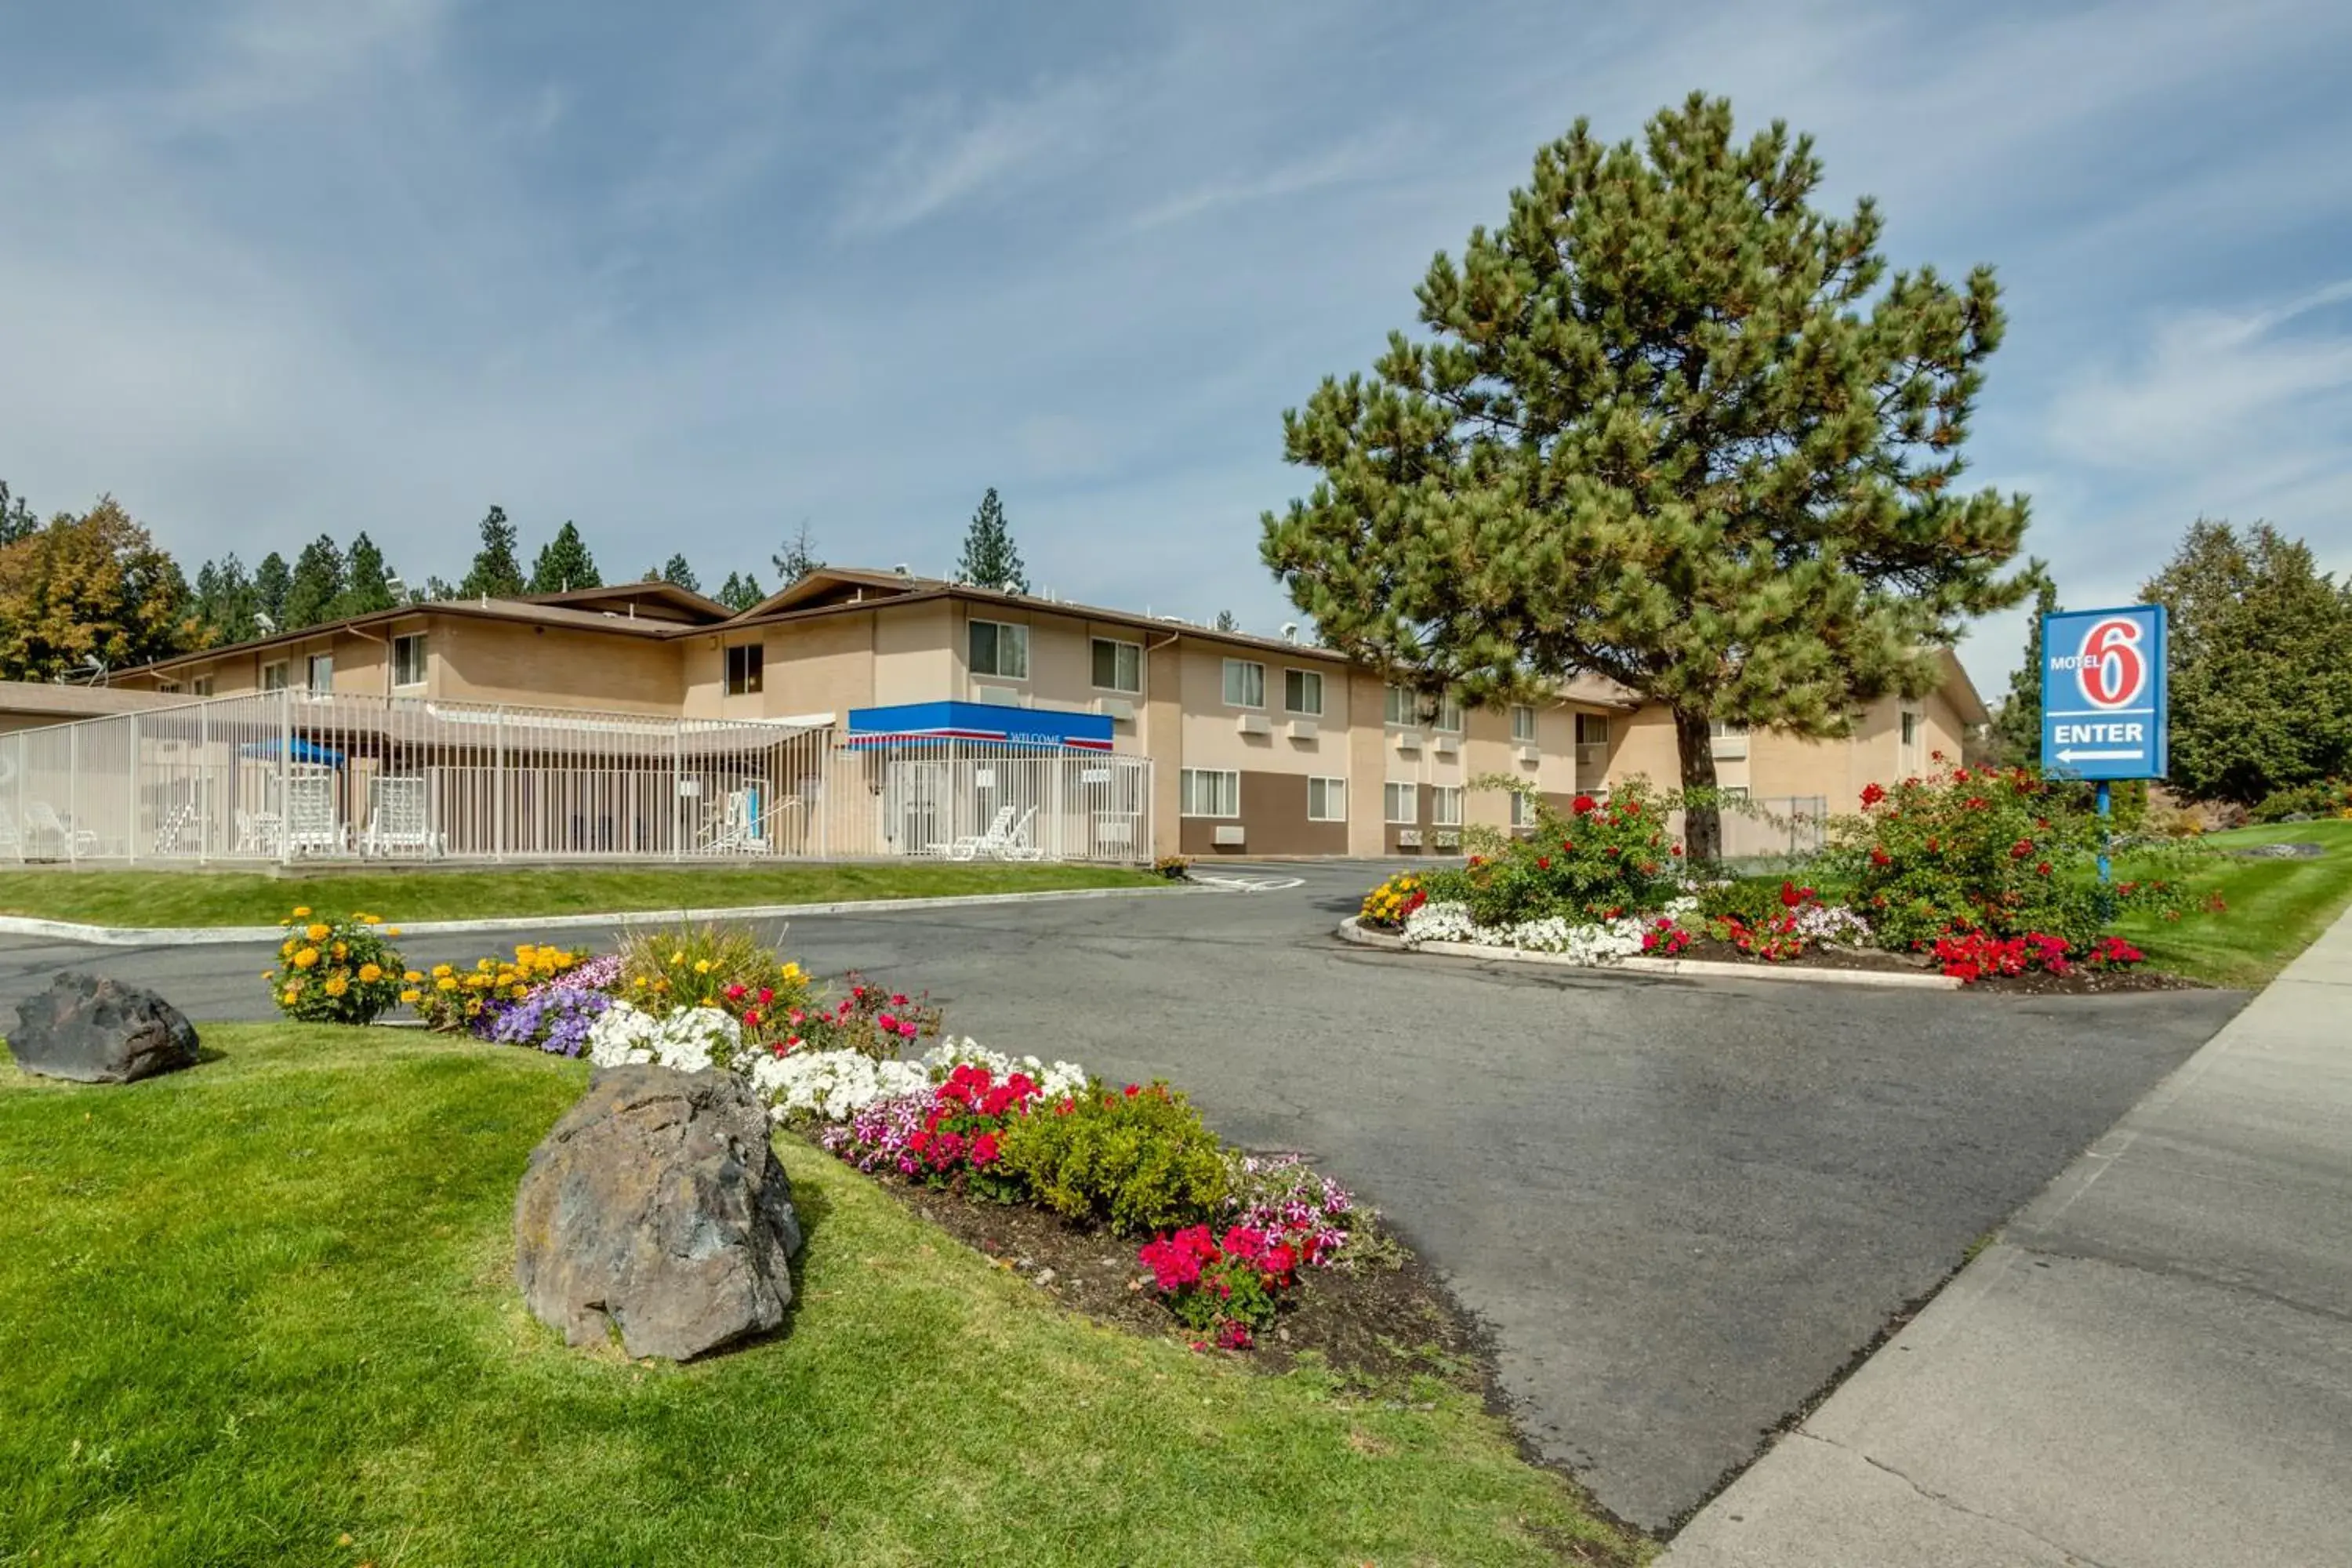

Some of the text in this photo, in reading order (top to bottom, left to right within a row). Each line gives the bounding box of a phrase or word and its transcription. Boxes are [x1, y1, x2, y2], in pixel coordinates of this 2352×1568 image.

[2051, 618, 2144, 709] MOTEL 6
[1011, 732, 1061, 745] WELCOME
[2054, 723, 2143, 743] ENTER
